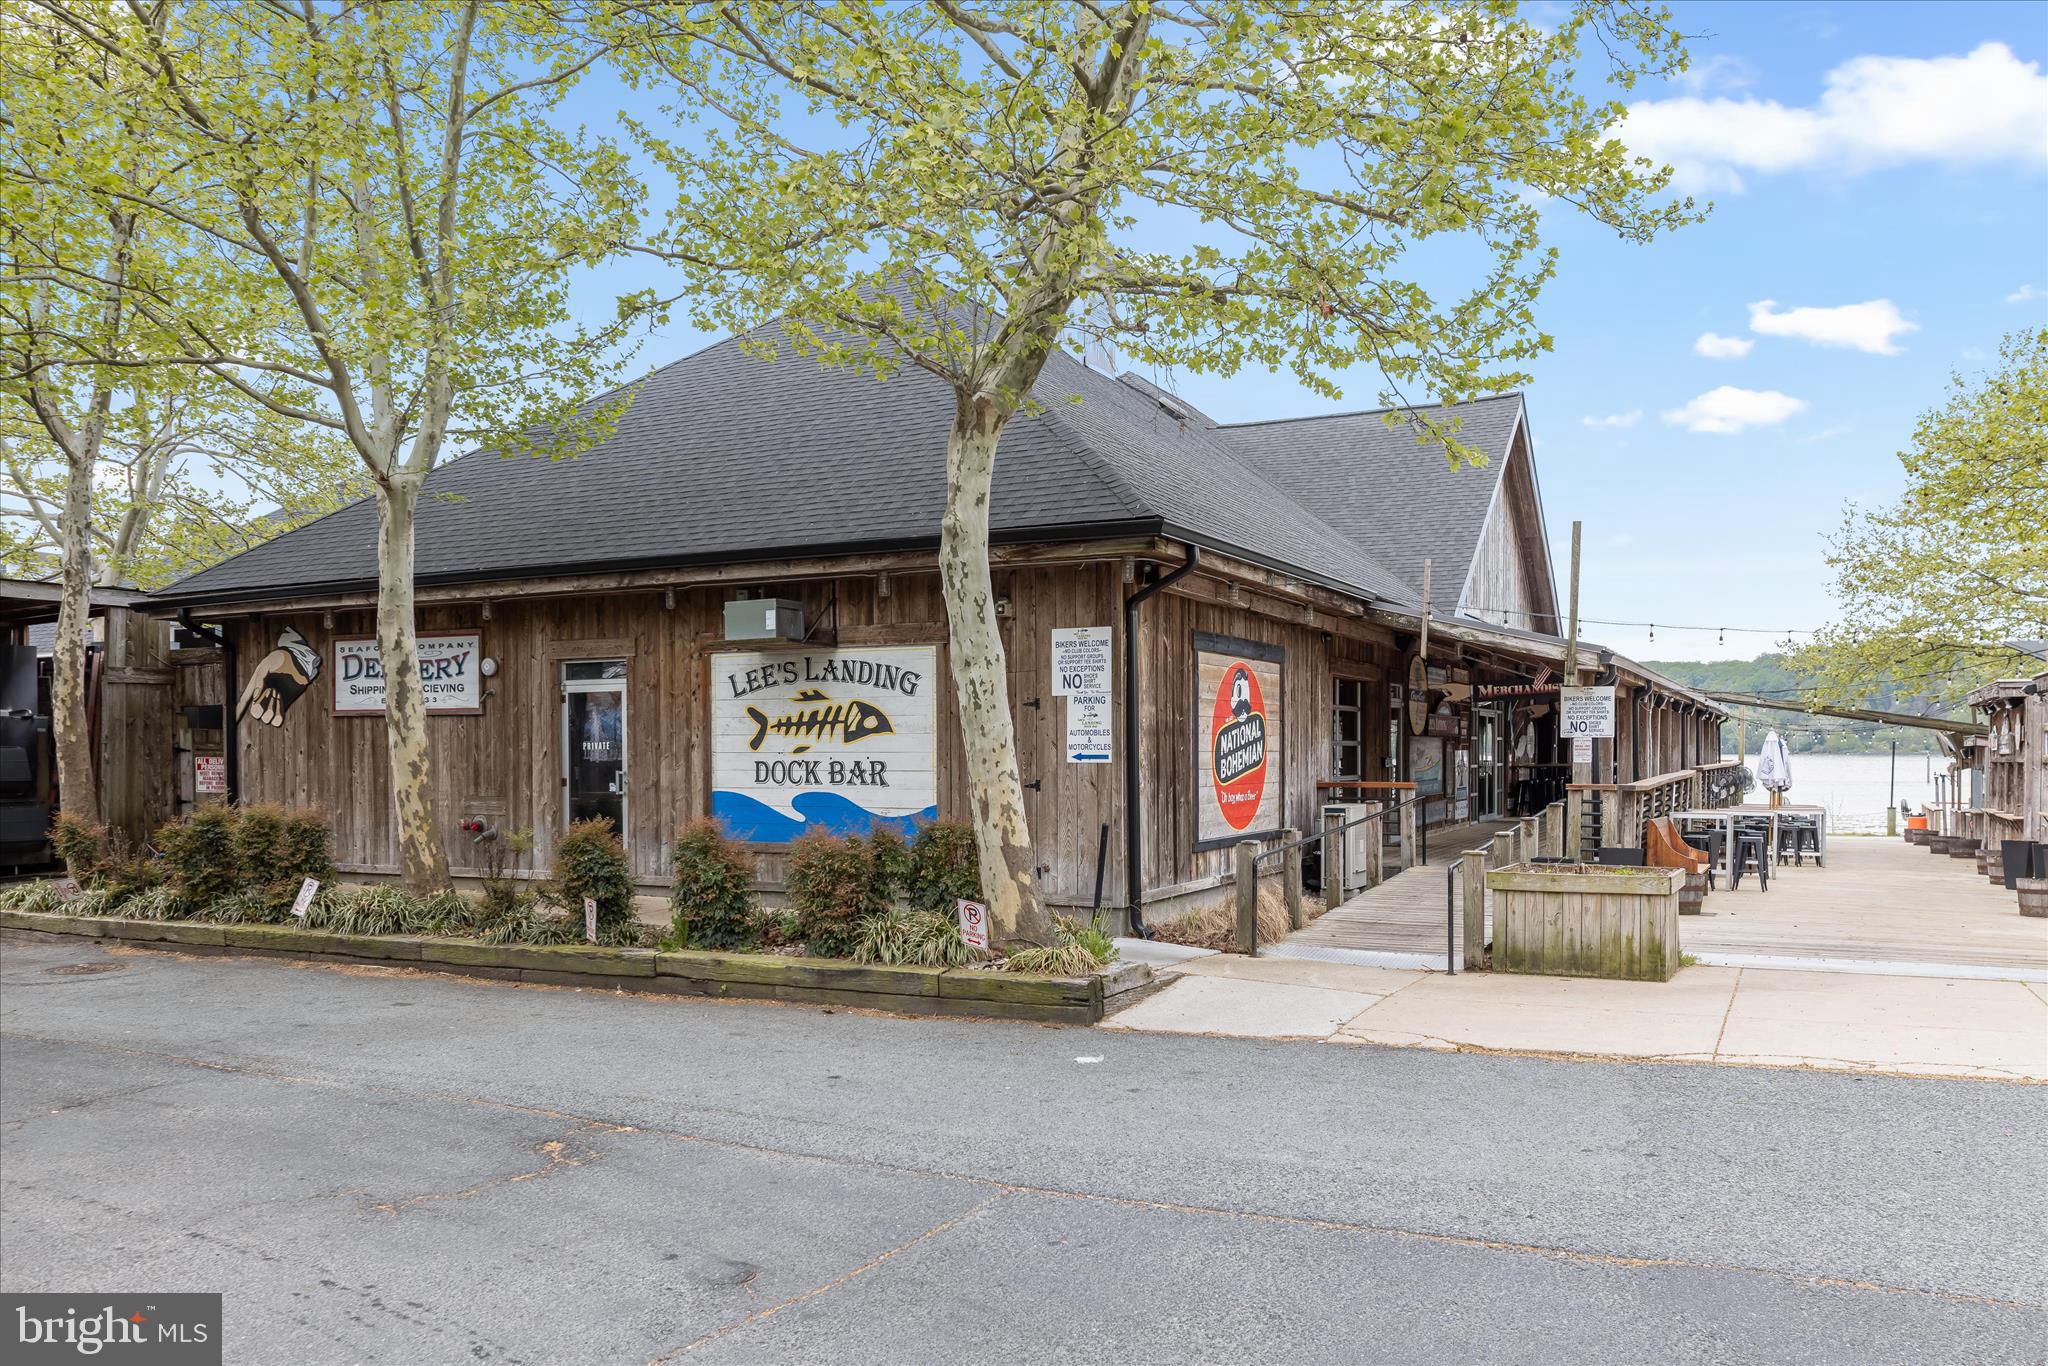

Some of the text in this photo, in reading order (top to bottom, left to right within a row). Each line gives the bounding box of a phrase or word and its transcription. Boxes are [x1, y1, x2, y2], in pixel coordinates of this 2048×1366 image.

[339, 641, 475, 654] SEAFO OMPANY
[1055, 639, 1109, 648] BIKERS WELCOME
[341, 651, 470, 682] DEERY
[728, 656, 922, 698] LEE'S LANDING
[1062, 673, 1082, 689] NO
[350, 683, 465, 695] SHIPPIN CIEVING
[1478, 683, 1562, 699] MERCHANDIS
[1073, 696, 1106, 704] PARKING
[1570, 720, 1588, 733] NO
[1220, 719, 1262, 756] NATIONAL
[582, 741, 610, 750] PRIVATE
[1068, 743, 1112, 751] MOTORCYCLES
[1220, 740, 1263, 779] BOHEMIAN
[754, 760, 890, 787] DOCK BAR
[969, 924, 977, 932] NO
[962, 929, 986, 941] PARKING
